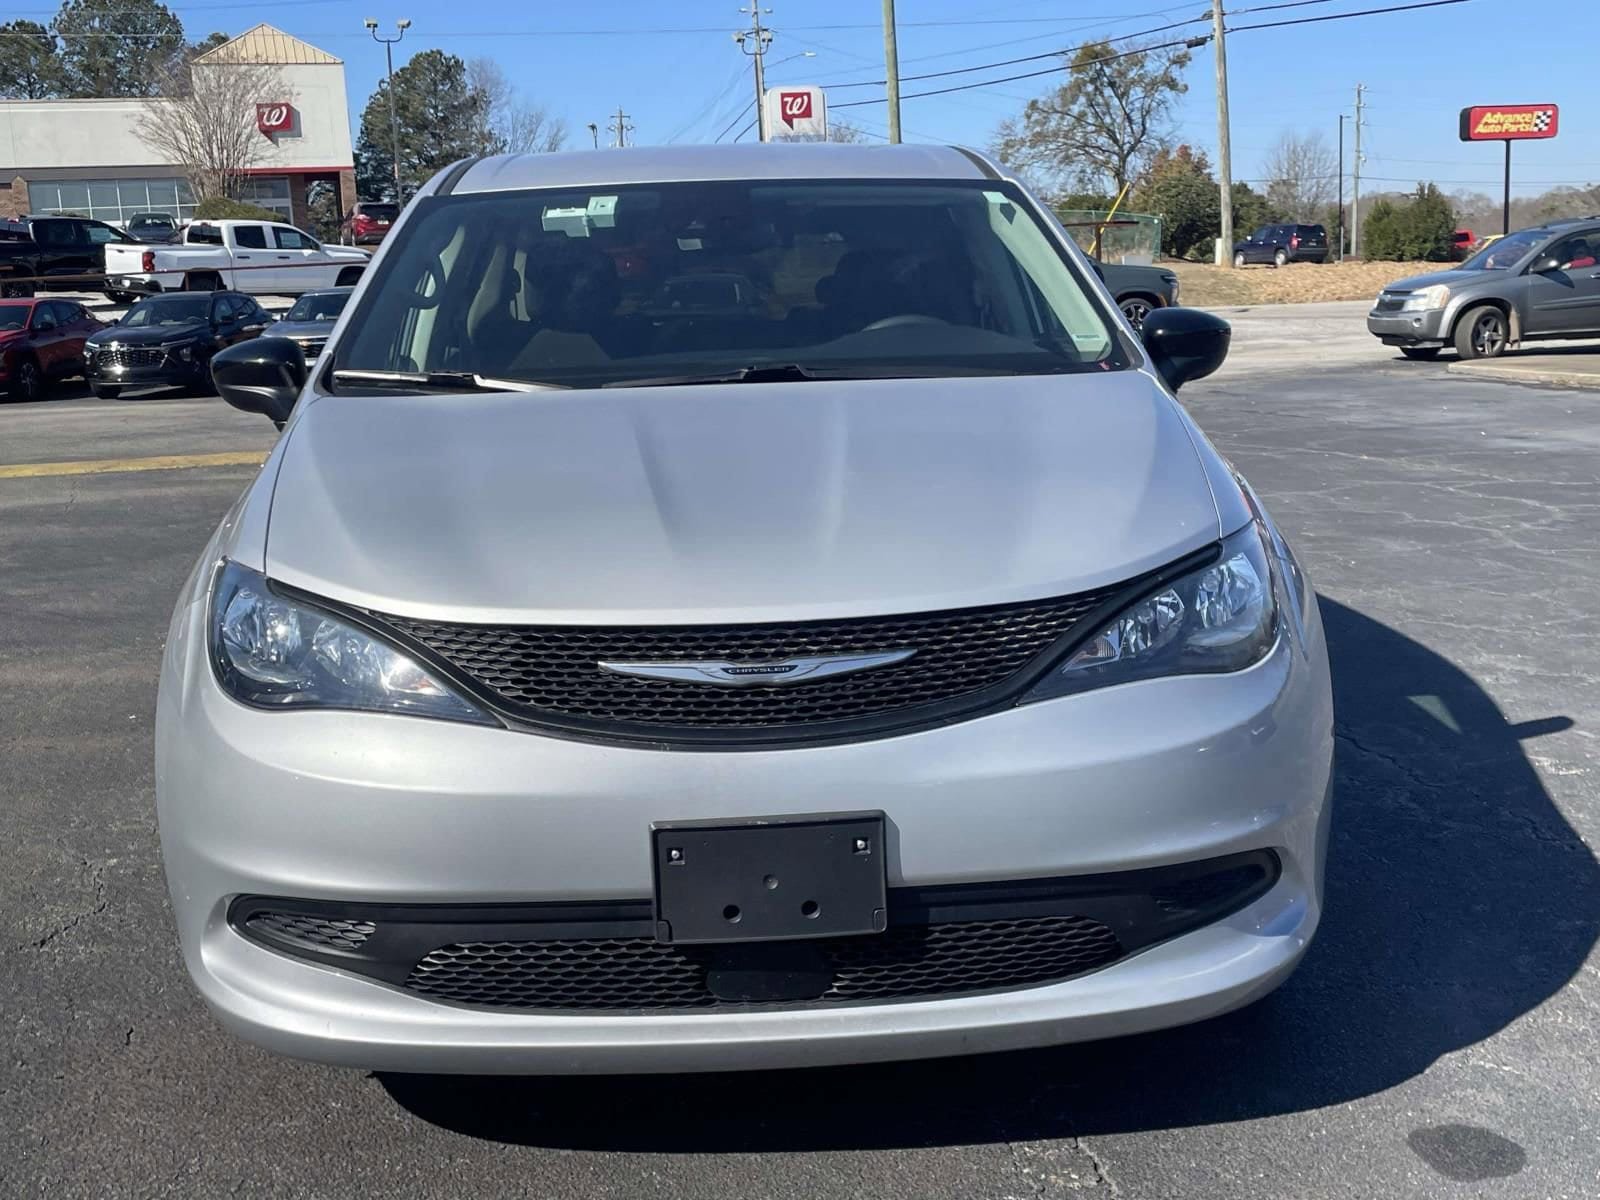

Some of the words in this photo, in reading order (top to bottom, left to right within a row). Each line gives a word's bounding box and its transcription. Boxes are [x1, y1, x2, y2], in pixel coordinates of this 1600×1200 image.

[1481, 112, 1532, 124] Advance
[1474, 123, 1501, 133] Auto
[1502, 122, 1531, 133] Parts
[728, 666, 790, 674] CHRYSLER
